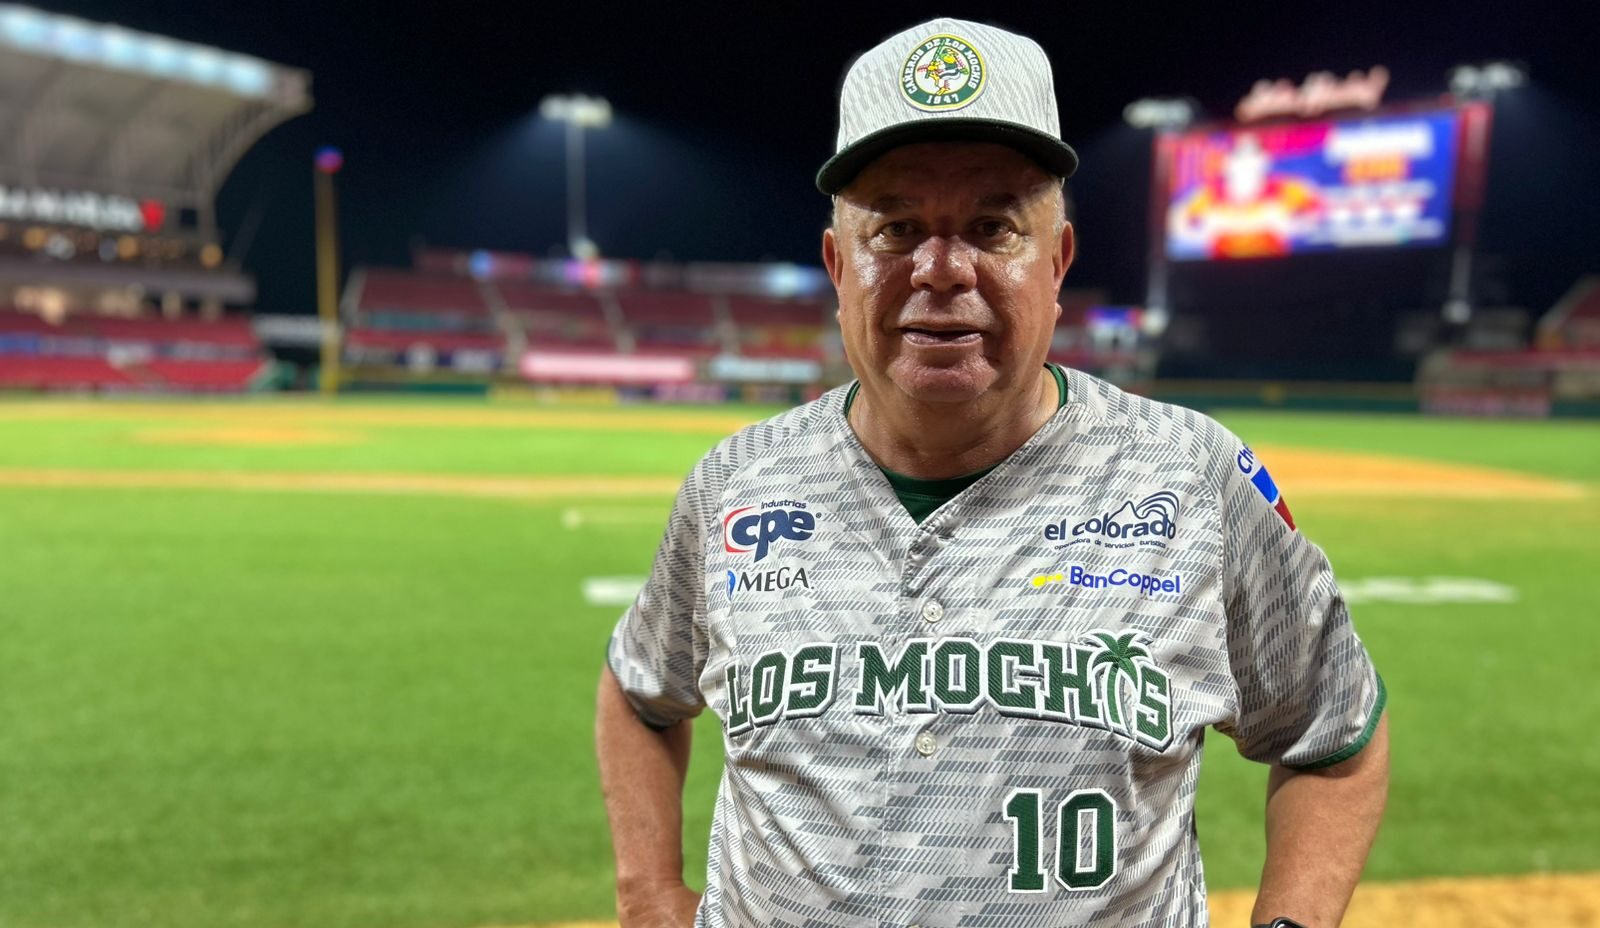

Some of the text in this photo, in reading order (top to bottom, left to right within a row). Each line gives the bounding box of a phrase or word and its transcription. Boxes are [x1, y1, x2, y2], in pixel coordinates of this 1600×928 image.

[945, 38, 966, 51] LOS
[964, 50, 981, 90] MOCHIS
[761, 499, 807, 509] industrias
[731, 509, 816, 563] cpe
[1044, 511, 1176, 540] el colorado
[737, 566, 809, 592] MEGA
[1070, 565, 1180, 595] BanCoppel
[725, 629, 1174, 752] LOS MOCHIS
[1002, 788, 1117, 893] 10
